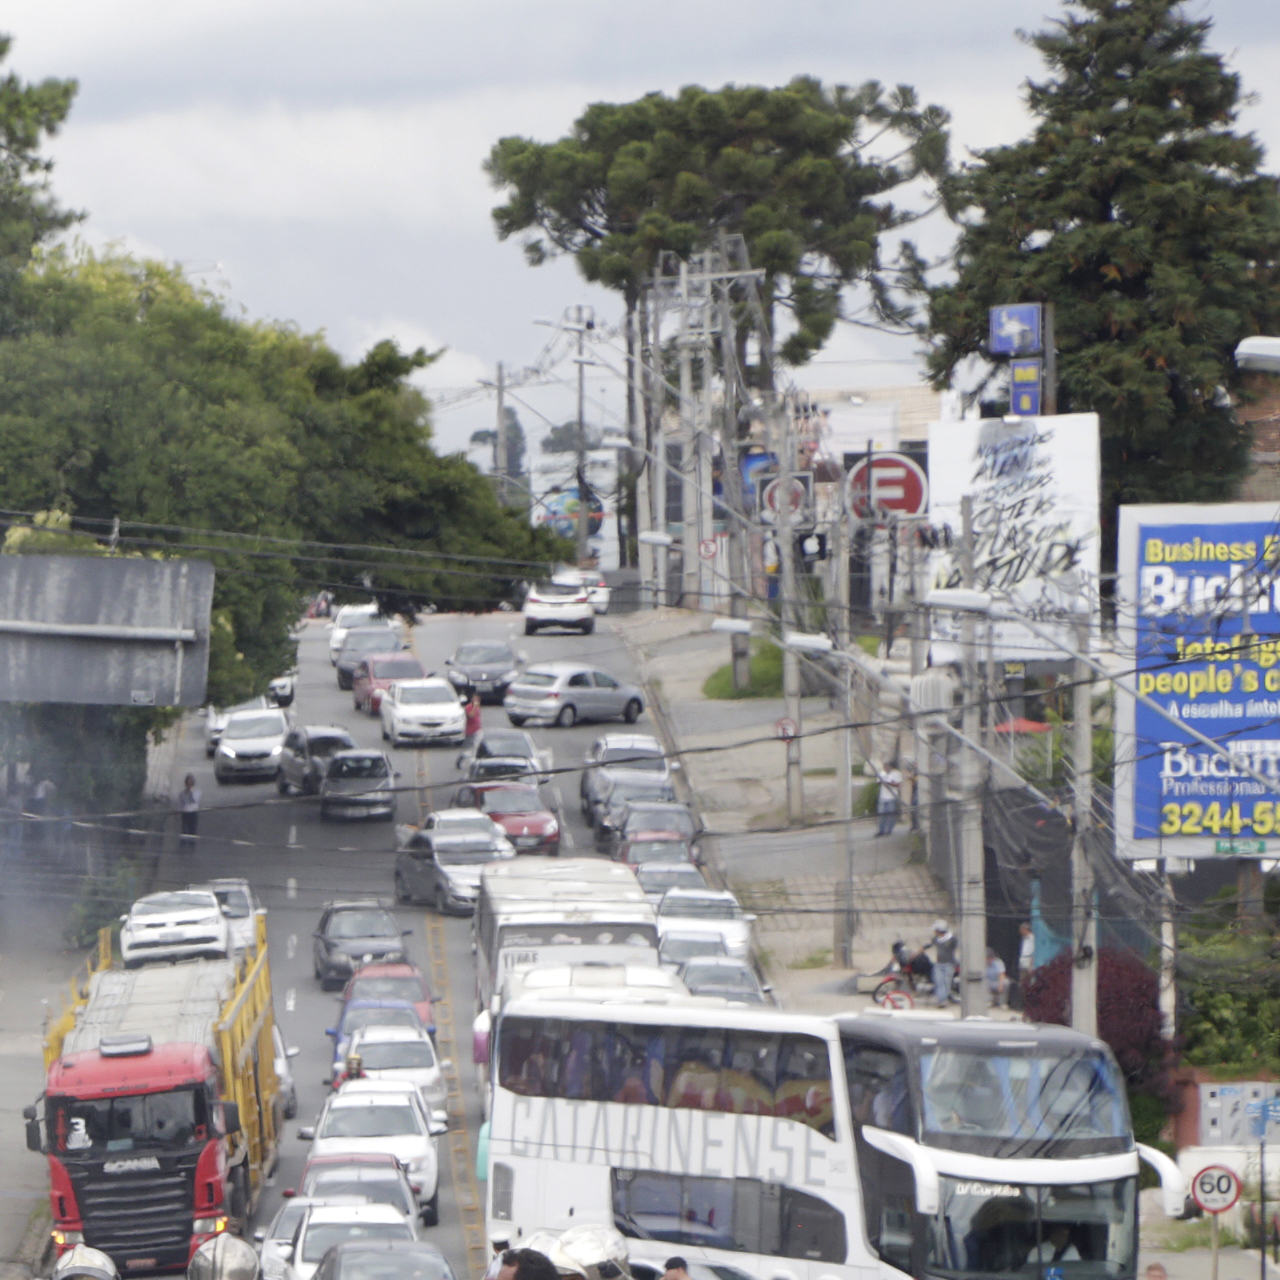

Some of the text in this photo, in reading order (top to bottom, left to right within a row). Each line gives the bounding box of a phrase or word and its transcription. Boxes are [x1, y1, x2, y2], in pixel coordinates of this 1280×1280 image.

[1145, 536, 1257, 563] Business
[1139, 664, 1259, 700] people's
[1182, 699, 1244, 718] escolha
[511, 1094, 827, 1187] CATARINENSE
[103, 1156, 161, 1173] SCANIA
[1200, 1172, 1232, 1194] 60
